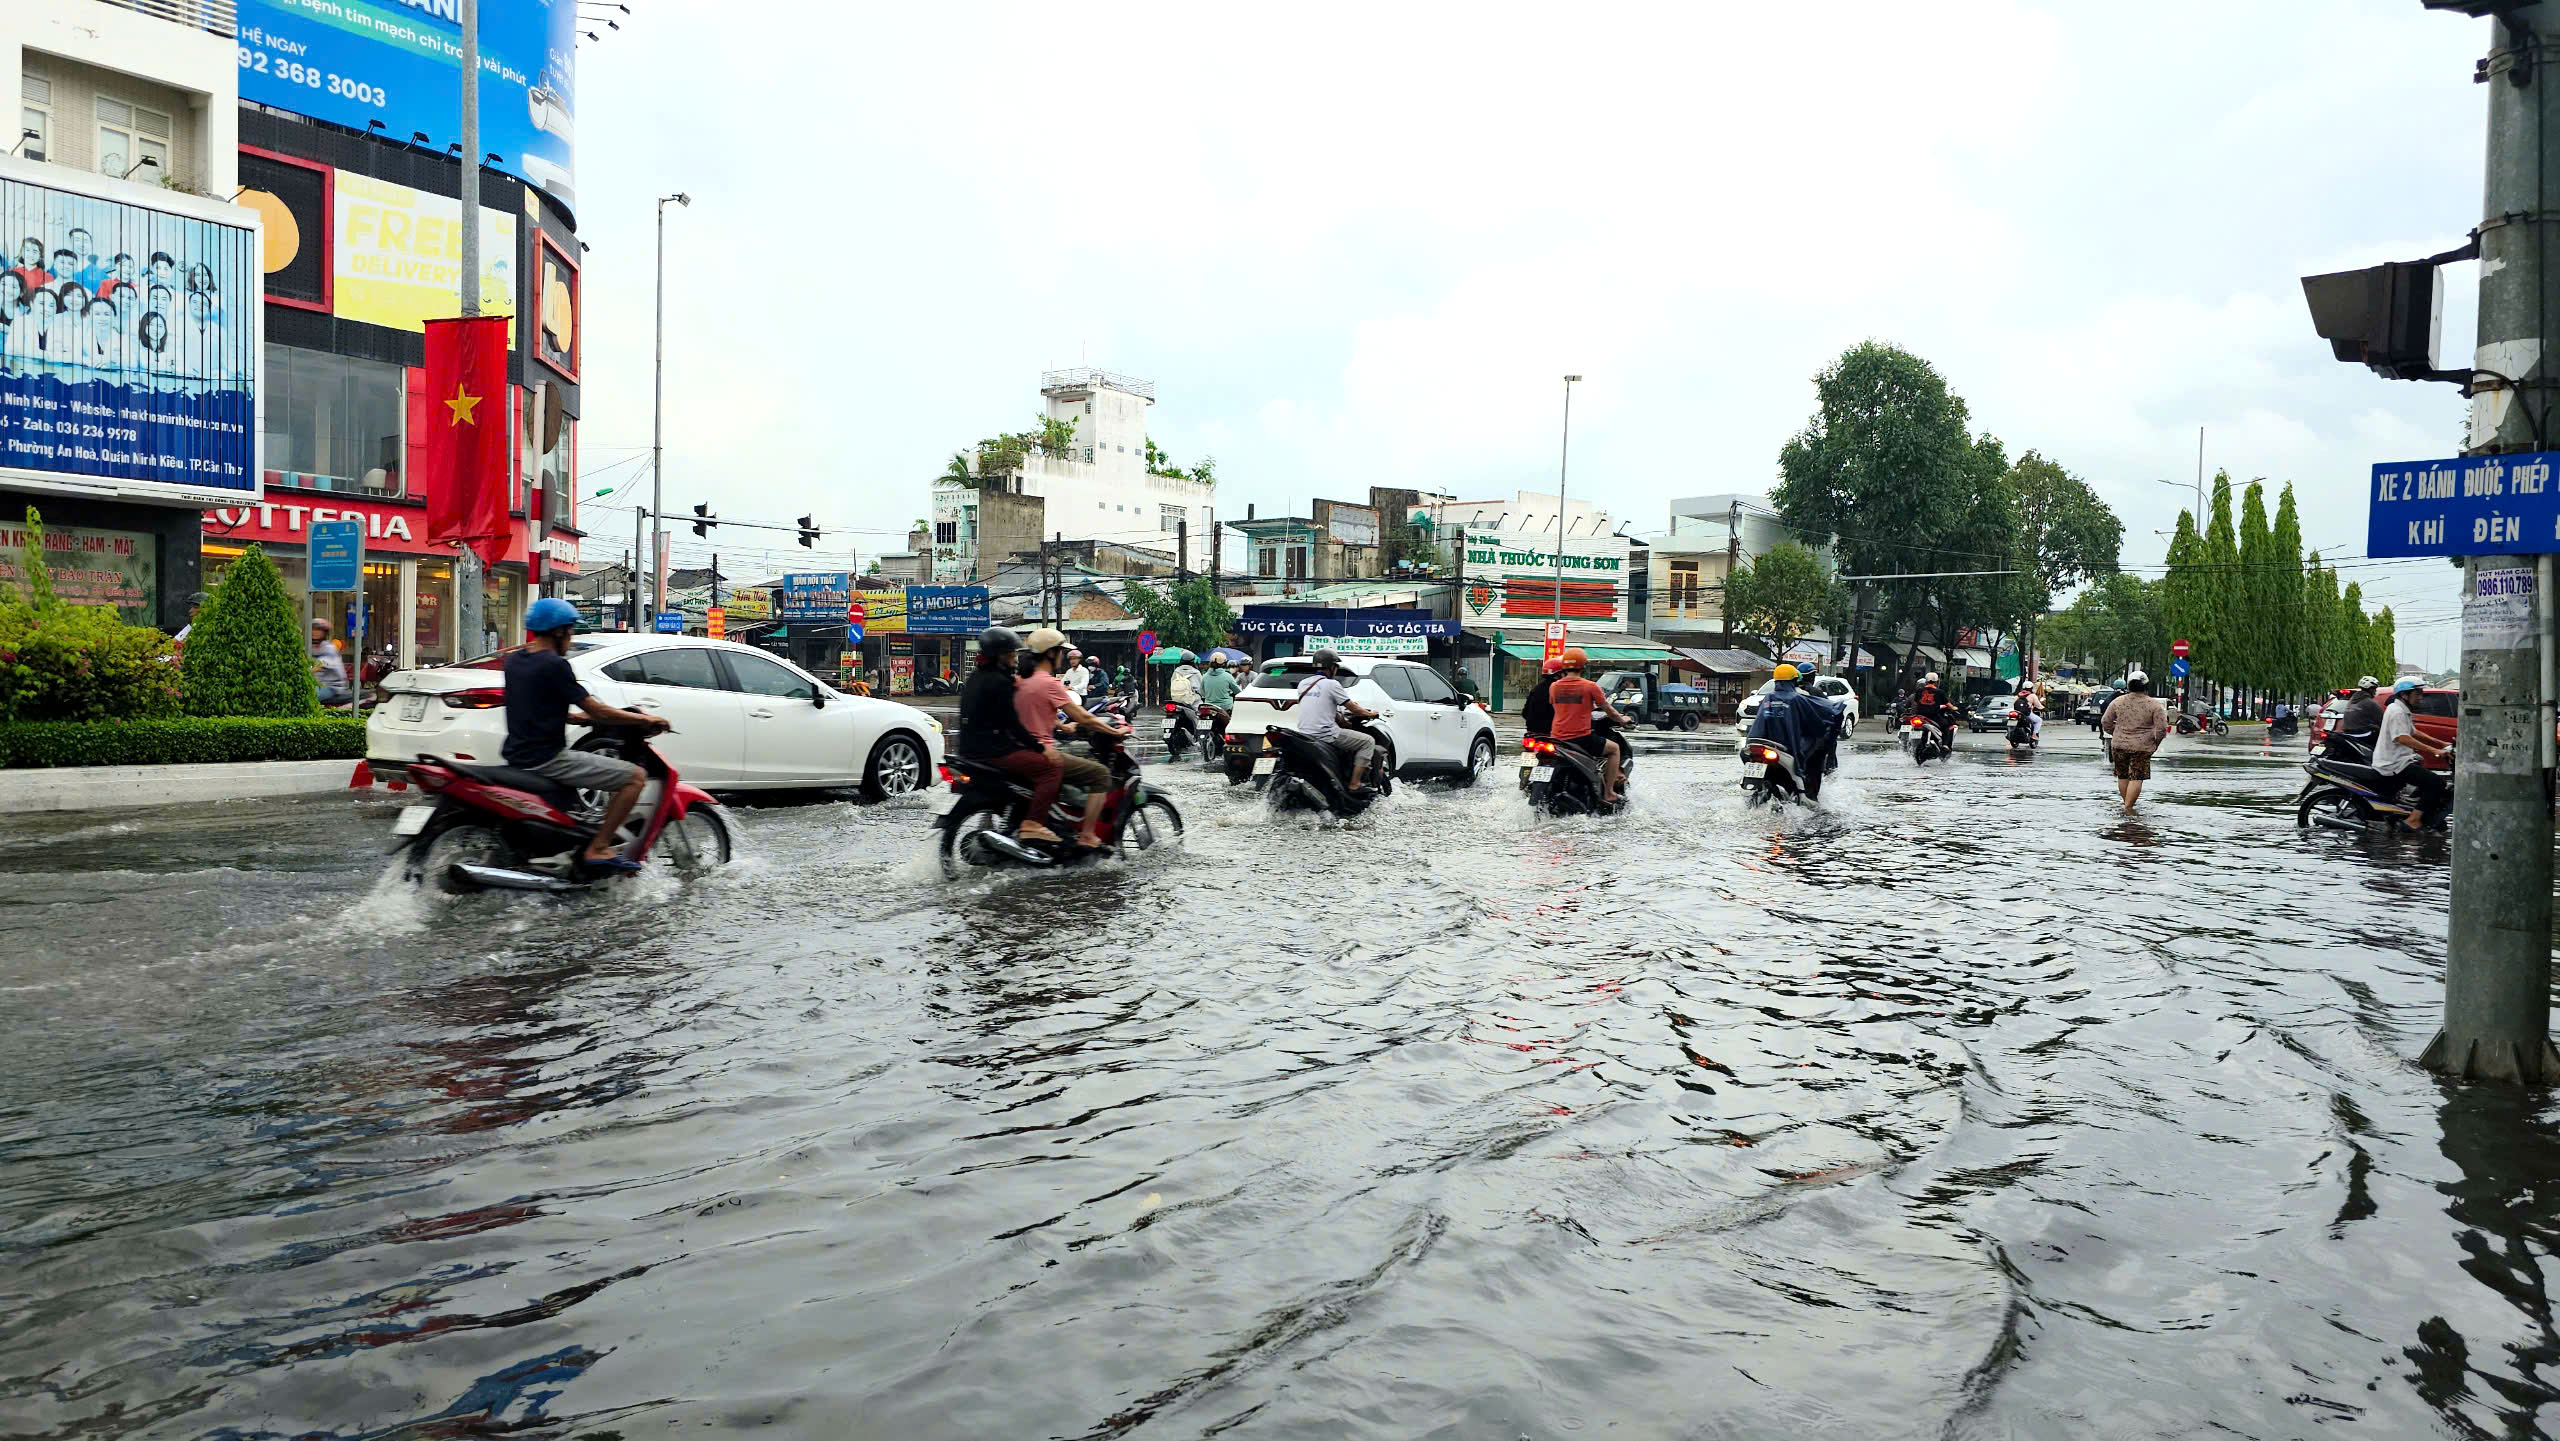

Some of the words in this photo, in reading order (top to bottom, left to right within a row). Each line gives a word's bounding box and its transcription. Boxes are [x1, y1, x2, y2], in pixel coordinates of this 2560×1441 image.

[242, 27, 263, 46] HỆ
[266, 34, 307, 57] NGAY
[345, 7, 372, 27] tim
[375, 19, 416, 42] mạch
[419, 33, 441, 51] chỉ
[444, 42, 480, 69] trog
[483, 57, 501, 74] vài
[502, 67, 527, 87] phút
[275, 58, 321, 88] 368
[327, 74, 386, 108] 3003
[352, 253, 461, 287] DELIVERY
[5, 392, 30, 407] Ninh
[70, 400, 116, 417] Website:
[23, 417, 54, 432] Zalo:
[56, 421, 79, 435] 036
[82, 425, 104, 438] 236
[107, 428, 137, 441] 9978
[8, 439, 54, 459] Phường
[57, 444, 72, 458] An
[133, 452, 157, 466] Ninh
[2378, 473, 2398, 502] XE
[2402, 471, 2412, 500] 2
[2417, 463, 2456, 500] BÁNH
[2464, 459, 2504, 501] ĐƯỢC
[2511, 457, 2550, 495] PHÉP
[2473, 510, 2520, 543] ĐÈN
[1467, 548, 1496, 564] NHÀ
[1500, 547, 1545, 566] THUỐC
[2478, 576, 2533, 596] 0986.110.789
[927, 596, 969, 610] MOBILE
[1300, 623, 1323, 633] TEA
[1425, 624, 1445, 633] TEA
